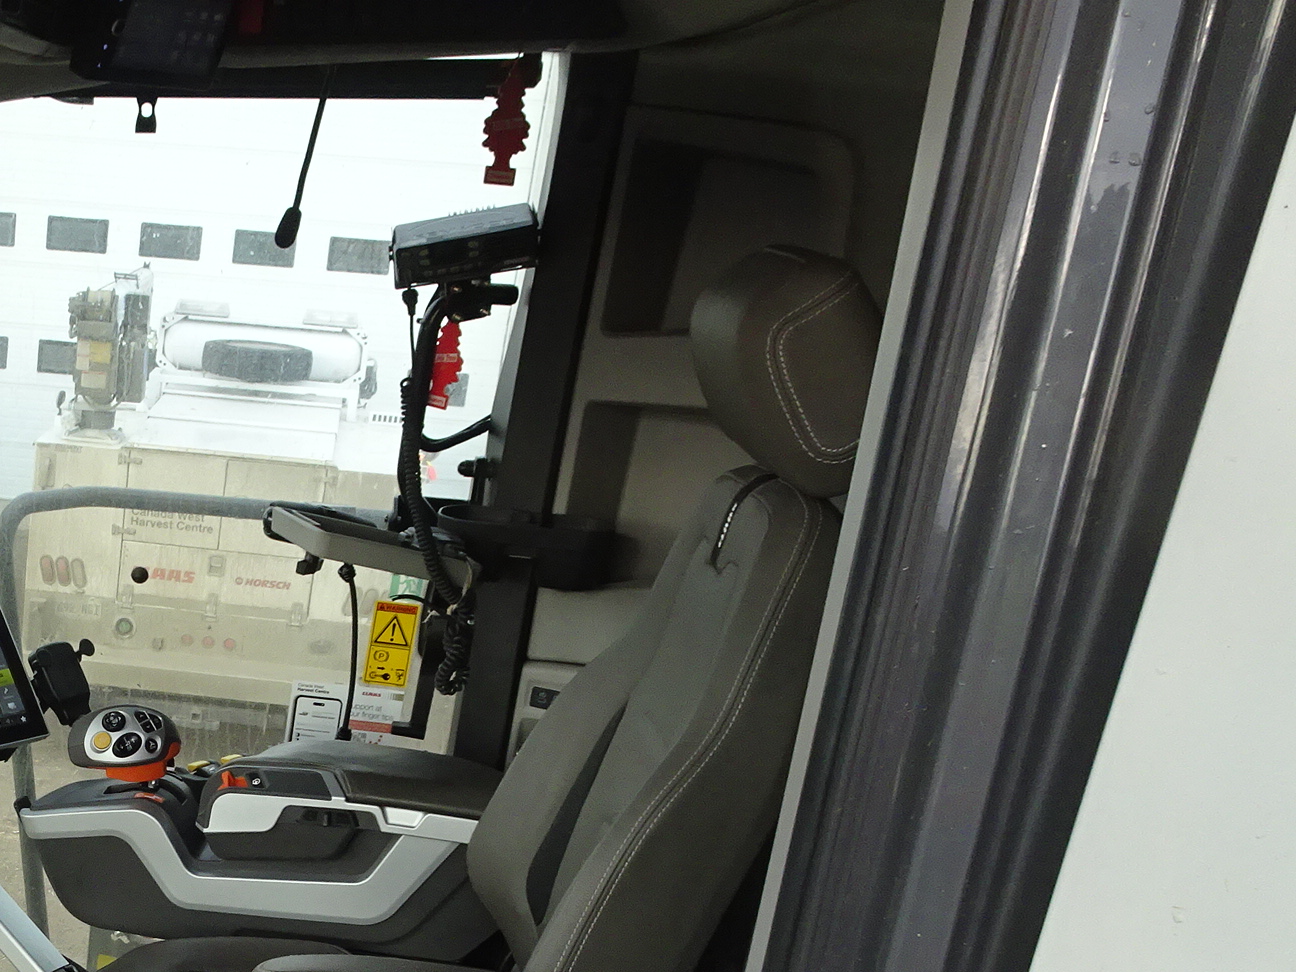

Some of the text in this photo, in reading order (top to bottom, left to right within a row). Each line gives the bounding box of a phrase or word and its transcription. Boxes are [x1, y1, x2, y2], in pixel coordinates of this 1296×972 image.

[130, 516, 214, 534] Harvest Centre
[146, 566, 196, 584] AAS
[244, 577, 292, 590] HORSCH
[386, 604, 416, 613] WARNING
[362, 710, 380, 720] finger
